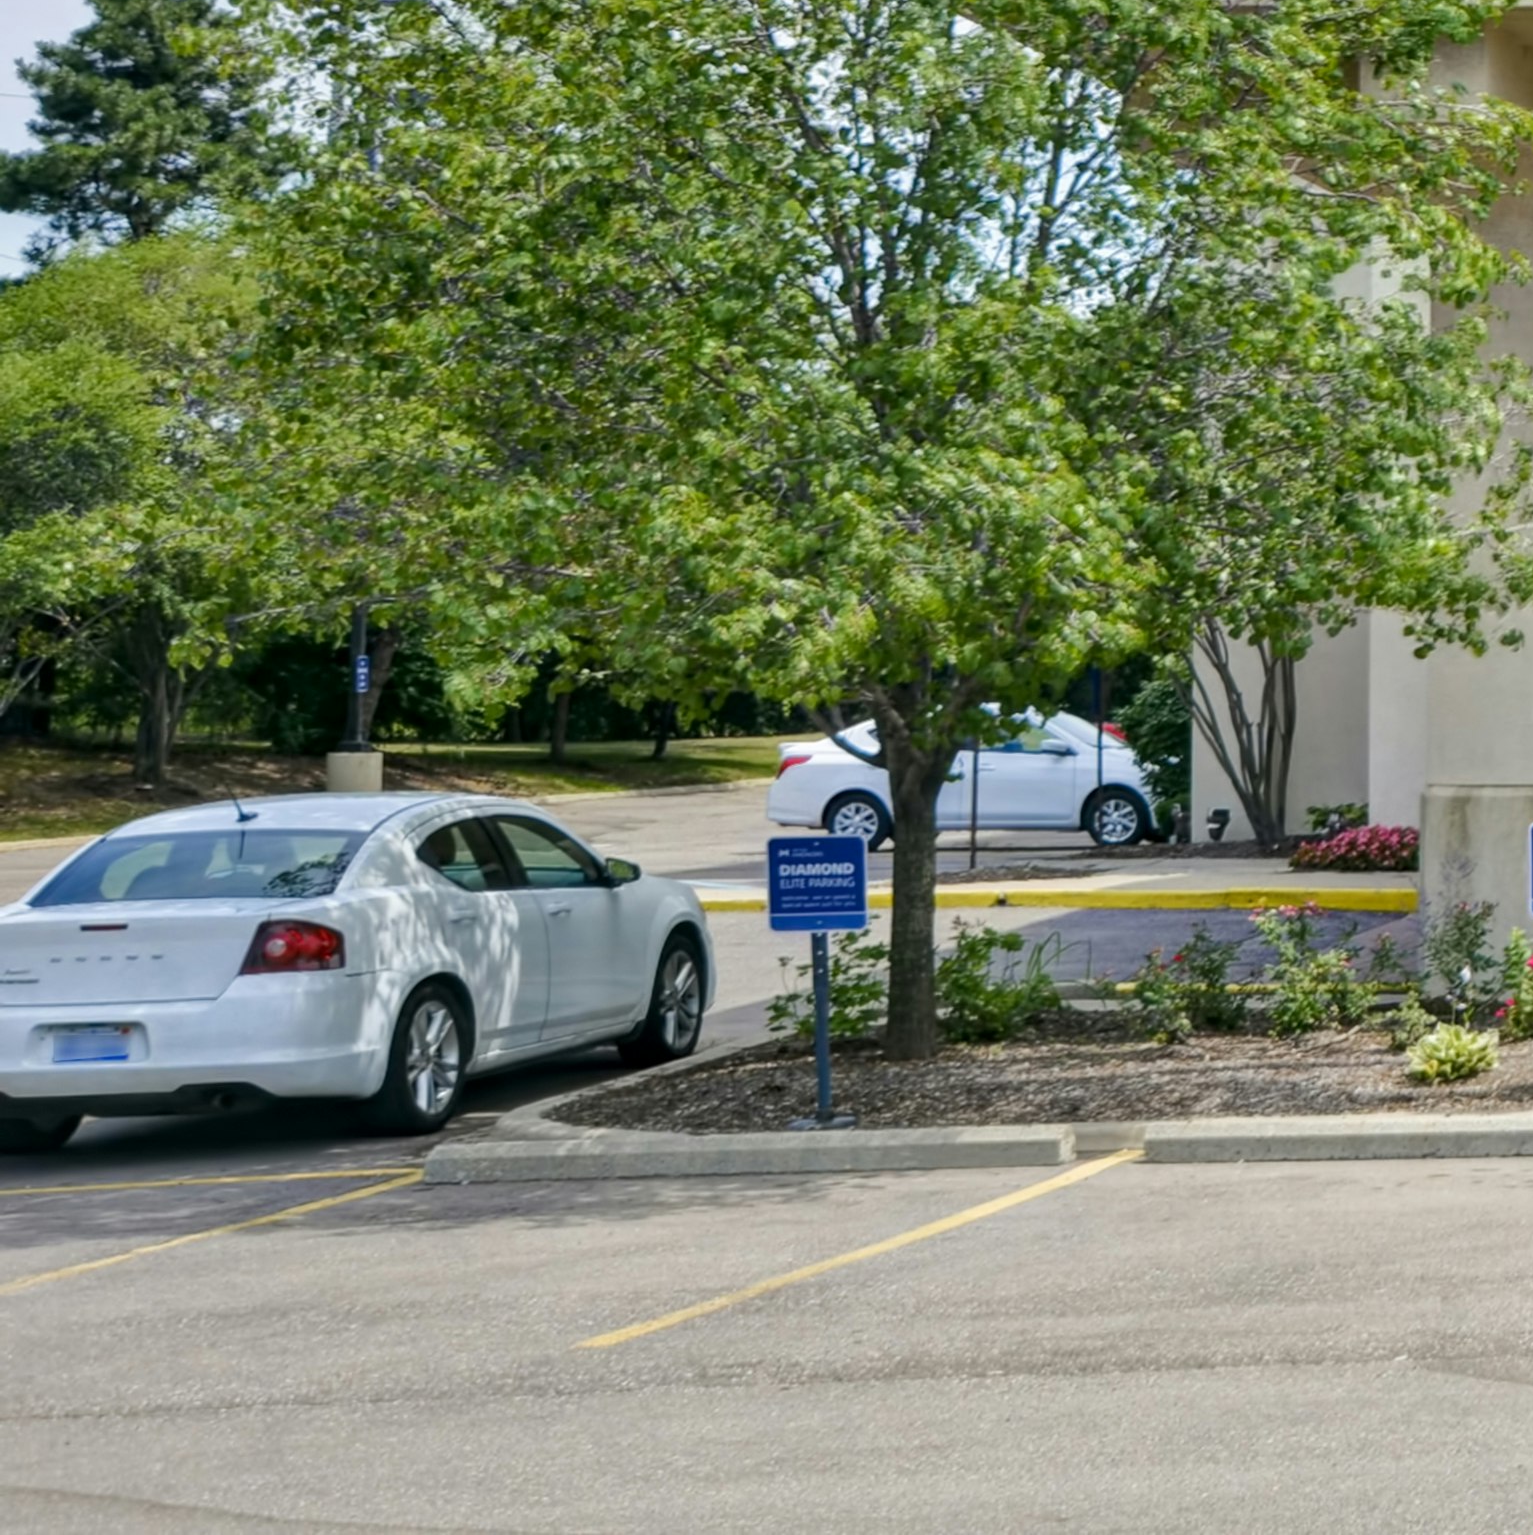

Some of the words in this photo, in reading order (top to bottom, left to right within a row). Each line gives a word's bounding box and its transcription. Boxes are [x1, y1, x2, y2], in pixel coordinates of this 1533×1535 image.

[779, 862, 855, 876] DIAMOND
[780, 878, 806, 889] ELITE
[809, 876, 855, 887] PARKING
